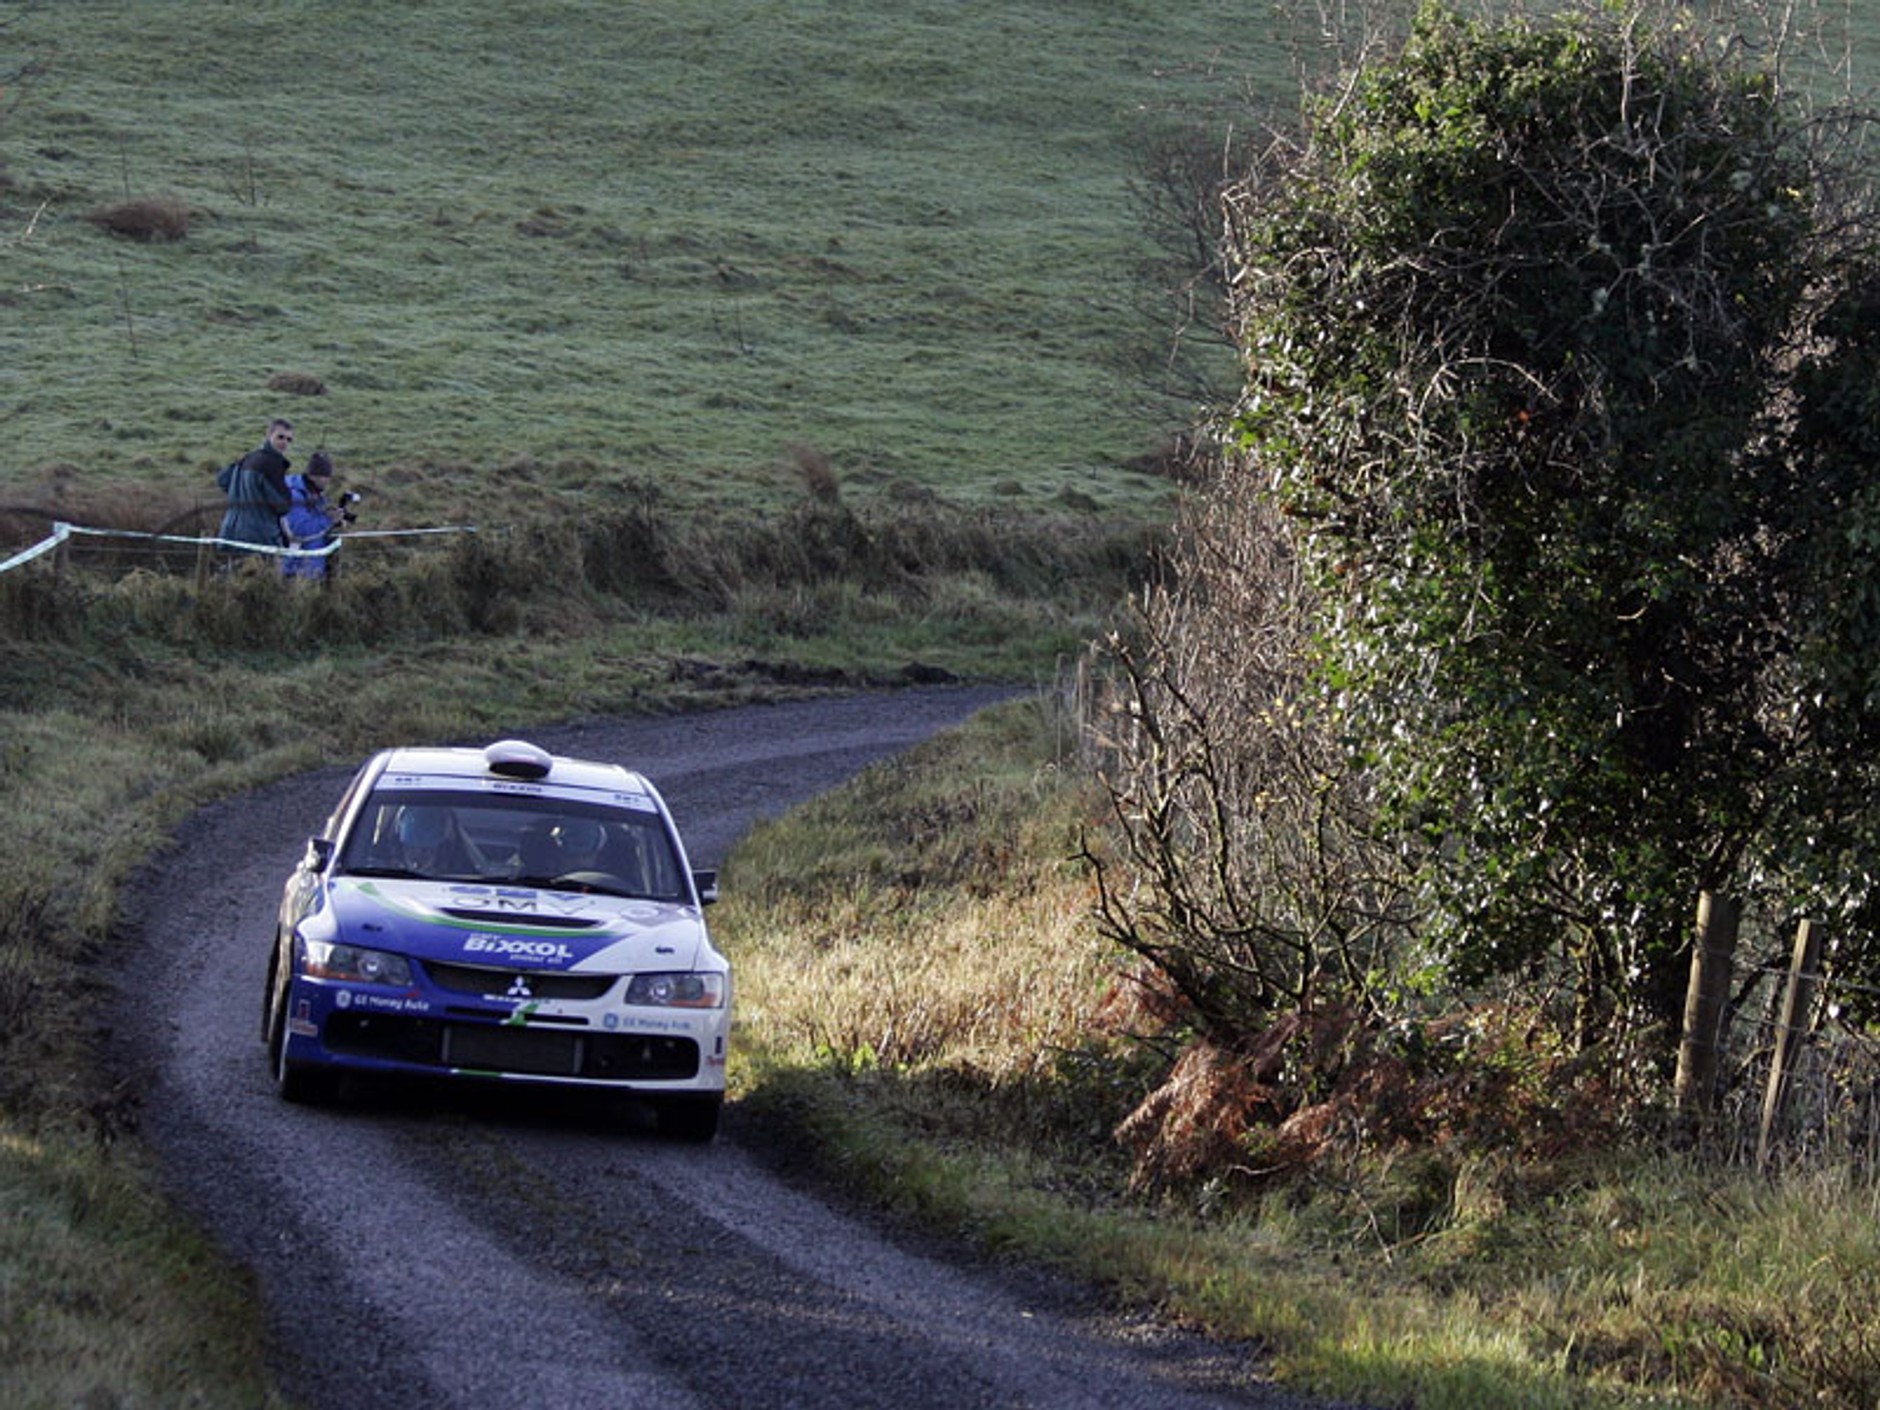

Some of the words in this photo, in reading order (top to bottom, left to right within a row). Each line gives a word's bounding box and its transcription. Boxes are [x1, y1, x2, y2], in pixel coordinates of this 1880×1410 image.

[450, 886, 587, 915] OMV
[354, 994, 367, 1005] GE
[369, 996, 402, 1010] Money
[404, 999, 430, 1011] Auto
